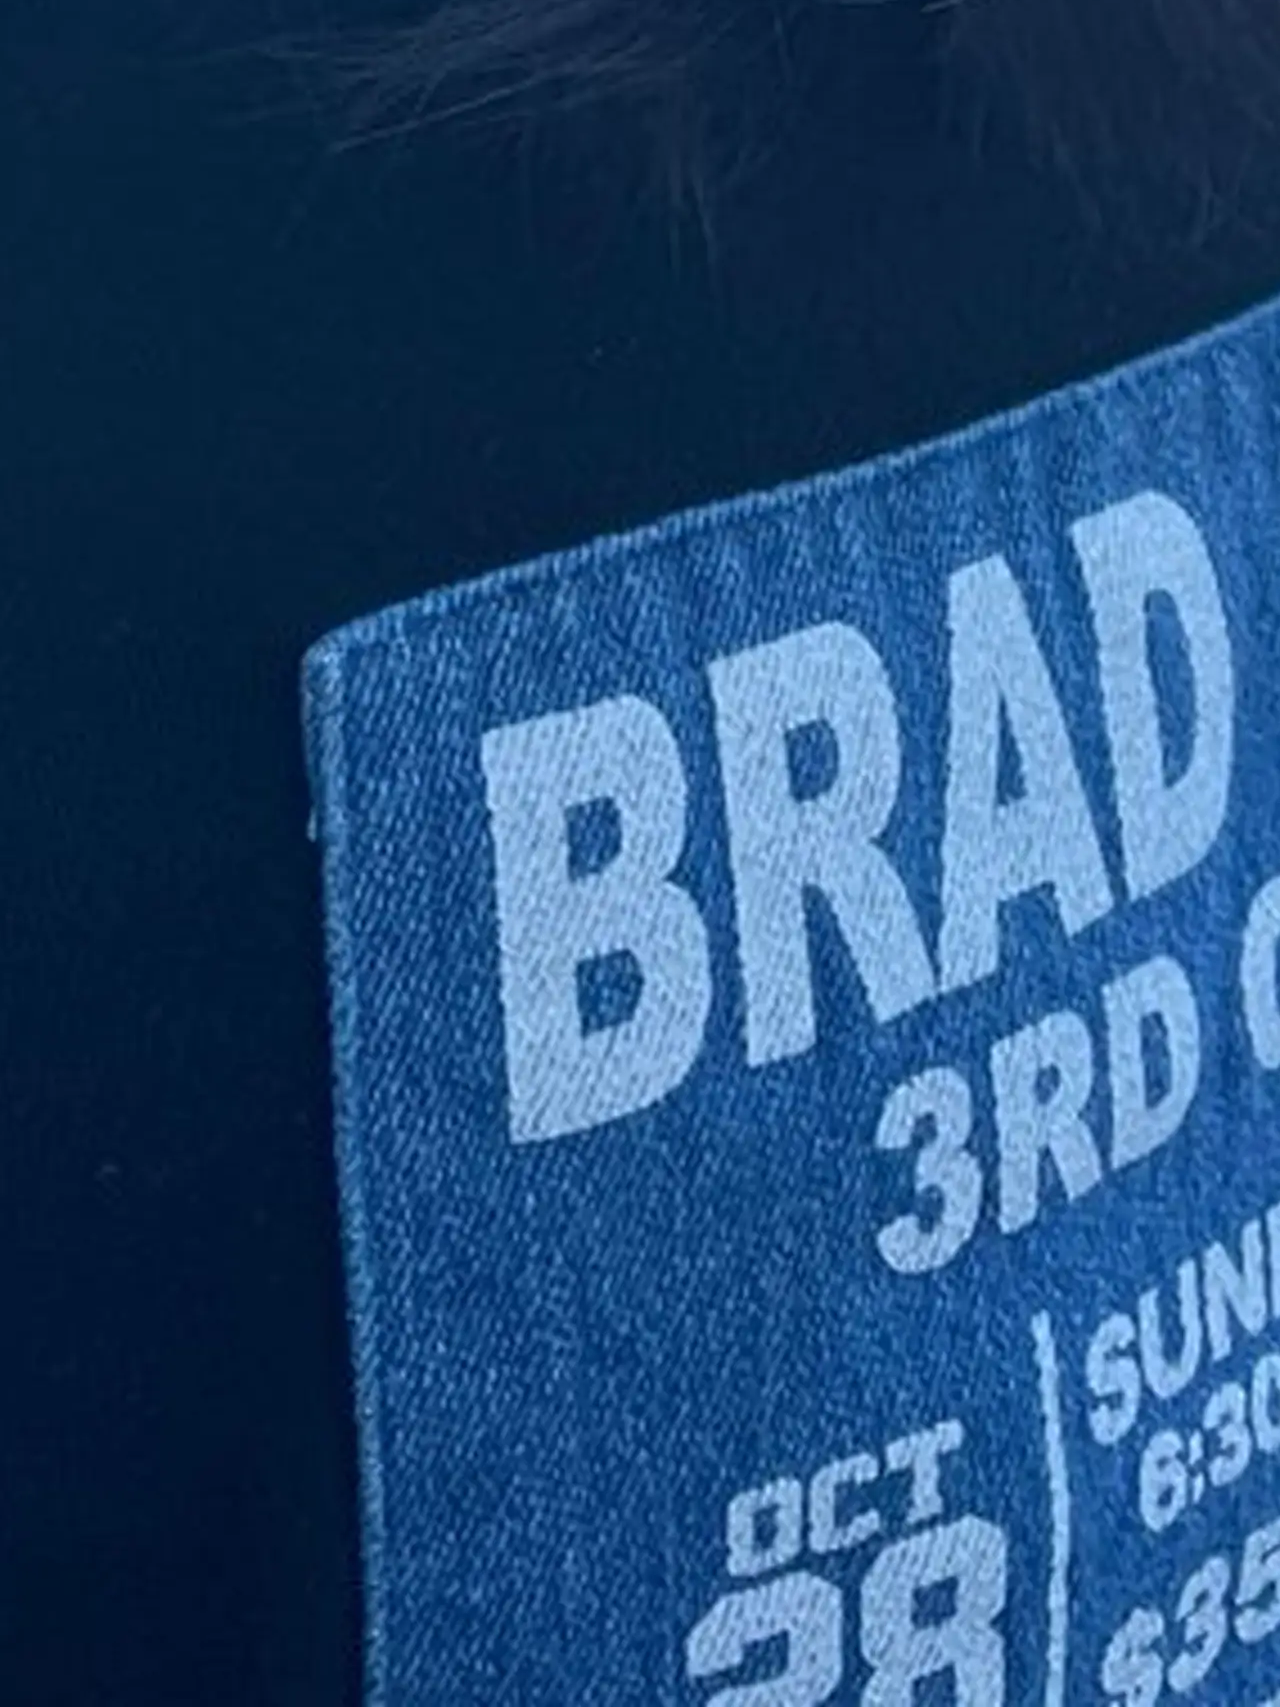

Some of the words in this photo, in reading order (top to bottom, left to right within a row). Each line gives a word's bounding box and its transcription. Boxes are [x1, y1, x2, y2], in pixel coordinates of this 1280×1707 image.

[481, 490, 1235, 1144] BRAD
[875, 955, 1201, 1275] 3RD
[685, 1514, 1008, 1707] 28
[726, 1418, 964, 1578] OCT
